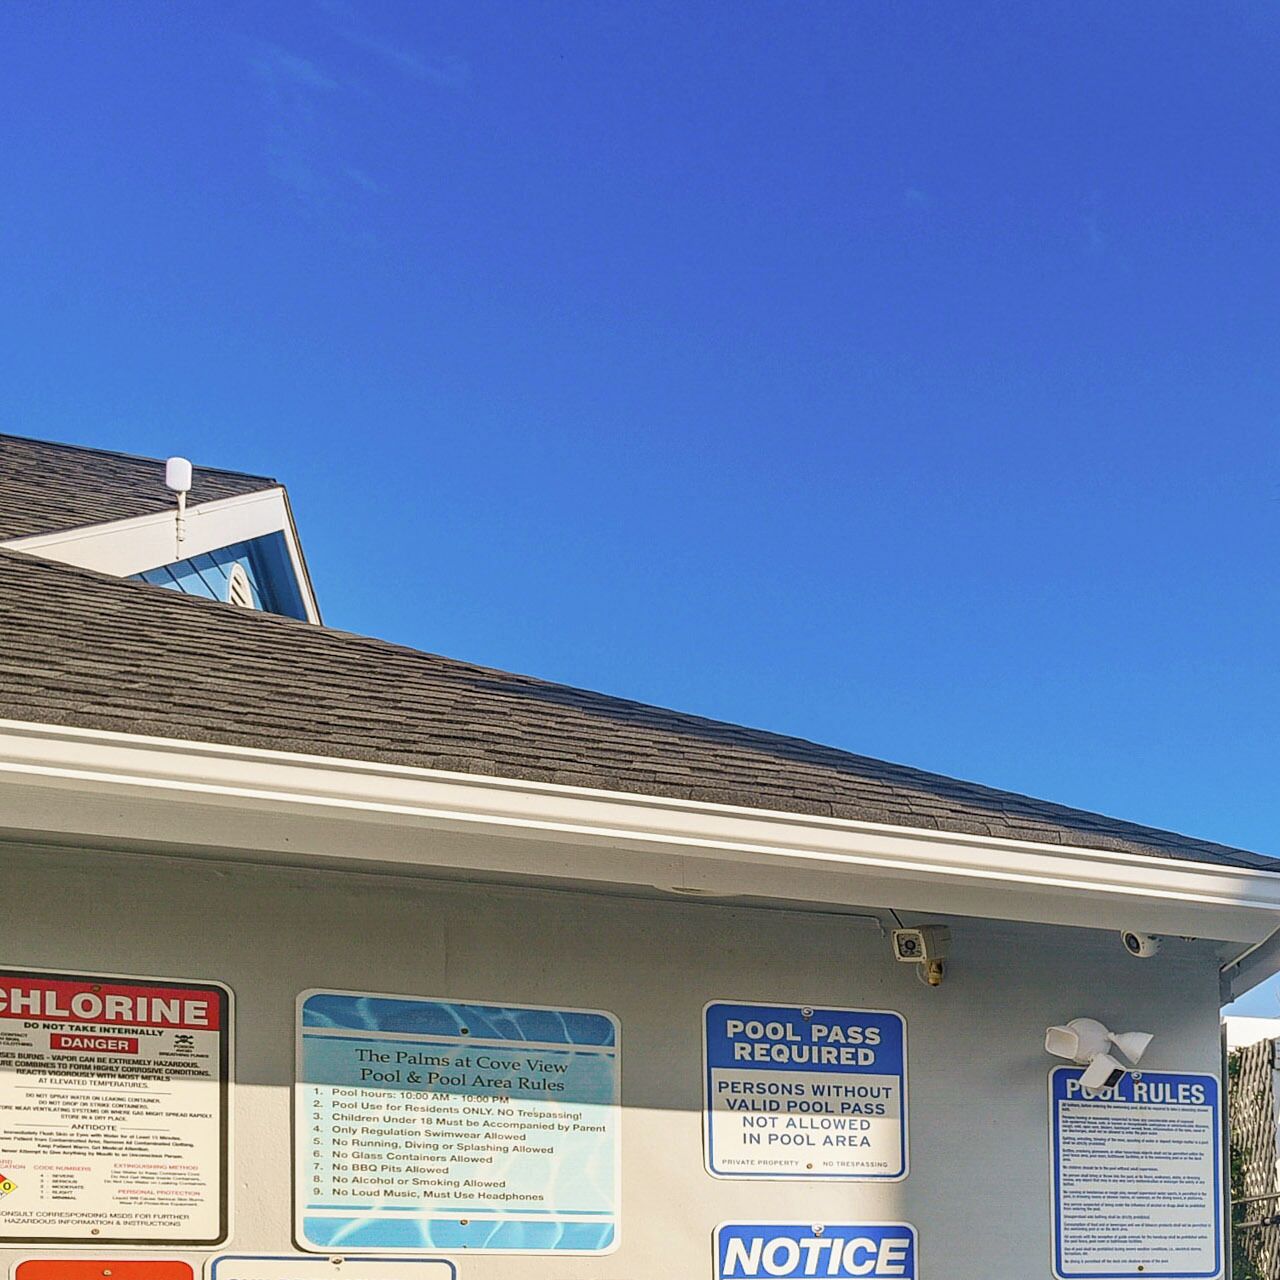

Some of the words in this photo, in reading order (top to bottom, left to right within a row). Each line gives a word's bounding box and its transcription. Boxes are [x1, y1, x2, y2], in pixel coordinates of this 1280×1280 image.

[0, 988, 209, 1026] HLORINE
[23, 1021, 40, 1029] DO
[42, 1023, 66, 1031] NOT
[68, 1024, 96, 1033] TAKE
[99, 1026, 165, 1037] INTERNALLY
[727, 1020, 801, 1041] POOL
[811, 1024, 881, 1045] PASS
[61, 1036, 129, 1051] DANGER
[17, 1052, 45, 1060] BURNS
[51, 1054, 77, 1062] VAPOR
[108, 1057, 152, 1066] EXTREMELY
[354, 1048, 391, 1063] The
[395, 1051, 450, 1067] Palms
[454, 1056, 472, 1068] at
[476, 1056, 521, 1071] Cove
[526, 1059, 568, 1073] View
[734, 1042, 875, 1066] REQUIRED
[14, 1060, 56, 1069] COMBINES
[69, 1063, 92, 1071] FORM
[93, 1064, 120, 1072] HIGHLY
[121, 1066, 164, 1075] CORROSIVE
[48, 1070, 95, 1078] VIGOROUSLY
[360, 1068, 401, 1083] Pool
[406, 1070, 422, 1084] &
[427, 1071, 466, 1087] Pool
[471, 1075, 512, 1089] Area
[518, 1077, 565, 1092] Rules
[332, 1088, 358, 1097] Pool
[361, 1090, 396, 1099] hours:
[400, 1092, 429, 1100] 10:00
[431, 1093, 450, 1101] AM
[461, 1095, 489, 1103] 10:00
[492, 1096, 510, 1104] PM
[718, 1081, 805, 1096] PERSONS
[811, 1084, 892, 1099] WITHOUT
[1134, 1082, 1205, 1104] RULES
[312, 1099, 324, 1108] 2.
[331, 1100, 358, 1109] Pool
[360, 1102, 383, 1110] Use
[386, 1103, 402, 1111] for
[404, 1104, 460, 1114] Residents
[497, 1108, 514, 1117] NO
[517, 1108, 582, 1121] Trespassing!
[725, 1098, 780, 1112] VALID
[787, 1100, 835, 1114] POOL
[841, 1102, 885, 1115] PASS
[71, 1124, 117, 1132] ANTIDOTE
[312, 1112, 323, 1120] 3.
[331, 1113, 380, 1123] Children
[382, 1115, 417, 1124] Under
[420, 1117, 433, 1125] 18
[435, 1117, 463, 1126] Must
[465, 1119, 480, 1127] be
[482, 1120, 555, 1131] Accompanied
[557, 1123, 570, 1132] by
[572, 1123, 606, 1132] Parent
[743, 1116, 779, 1128] NOT
[785, 1117, 871, 1131] ALLOWED
[312, 1125, 323, 1133] 4.
[331, 1125, 358, 1136] Only
[361, 1126, 422, 1137] Regulation
[424, 1129, 481, 1139] Swimwear
[483, 1132, 526, 1141] Allowed
[743, 1133, 761, 1145] IN
[768, 1133, 816, 1146] POOL
[822, 1135, 871, 1148] AREA
[313, 1137, 324, 1145] 5.
[332, 1138, 348, 1146] No
[404, 1140, 440, 1151] Diving
[456, 1142, 509, 1154] Splashing
[511, 1145, 554, 1154] Allowed
[312, 1150, 323, 1158] 6.
[332, 1150, 349, 1159] No
[351, 1151, 383, 1160] Glass
[386, 1152, 447, 1162] Containers
[449, 1154, 493, 1164] Allowed
[313, 1162, 324, 1171] 7.
[332, 1163, 348, 1171] No
[351, 1163, 378, 1172] BBQ
[380, 1164, 402, 1173] Pits
[404, 1165, 449, 1175] Allowed
[313, 1175, 324, 1183] 8.
[332, 1175, 349, 1184] No
[351, 1176, 395, 1185] Alcohol
[411, 1177, 460, 1188] Smoking
[462, 1179, 506, 1188] Allowed
[312, 1187, 324, 1196] 9.
[332, 1188, 349, 1196] No
[351, 1188, 381, 1197] Loud
[383, 1189, 420, 1199] Music,
[423, 1190, 451, 1199] Must
[453, 1191, 475, 1199] Use
[477, 1192, 544, 1202] Headphones
[722, 1237, 910, 1276] NOTICE
